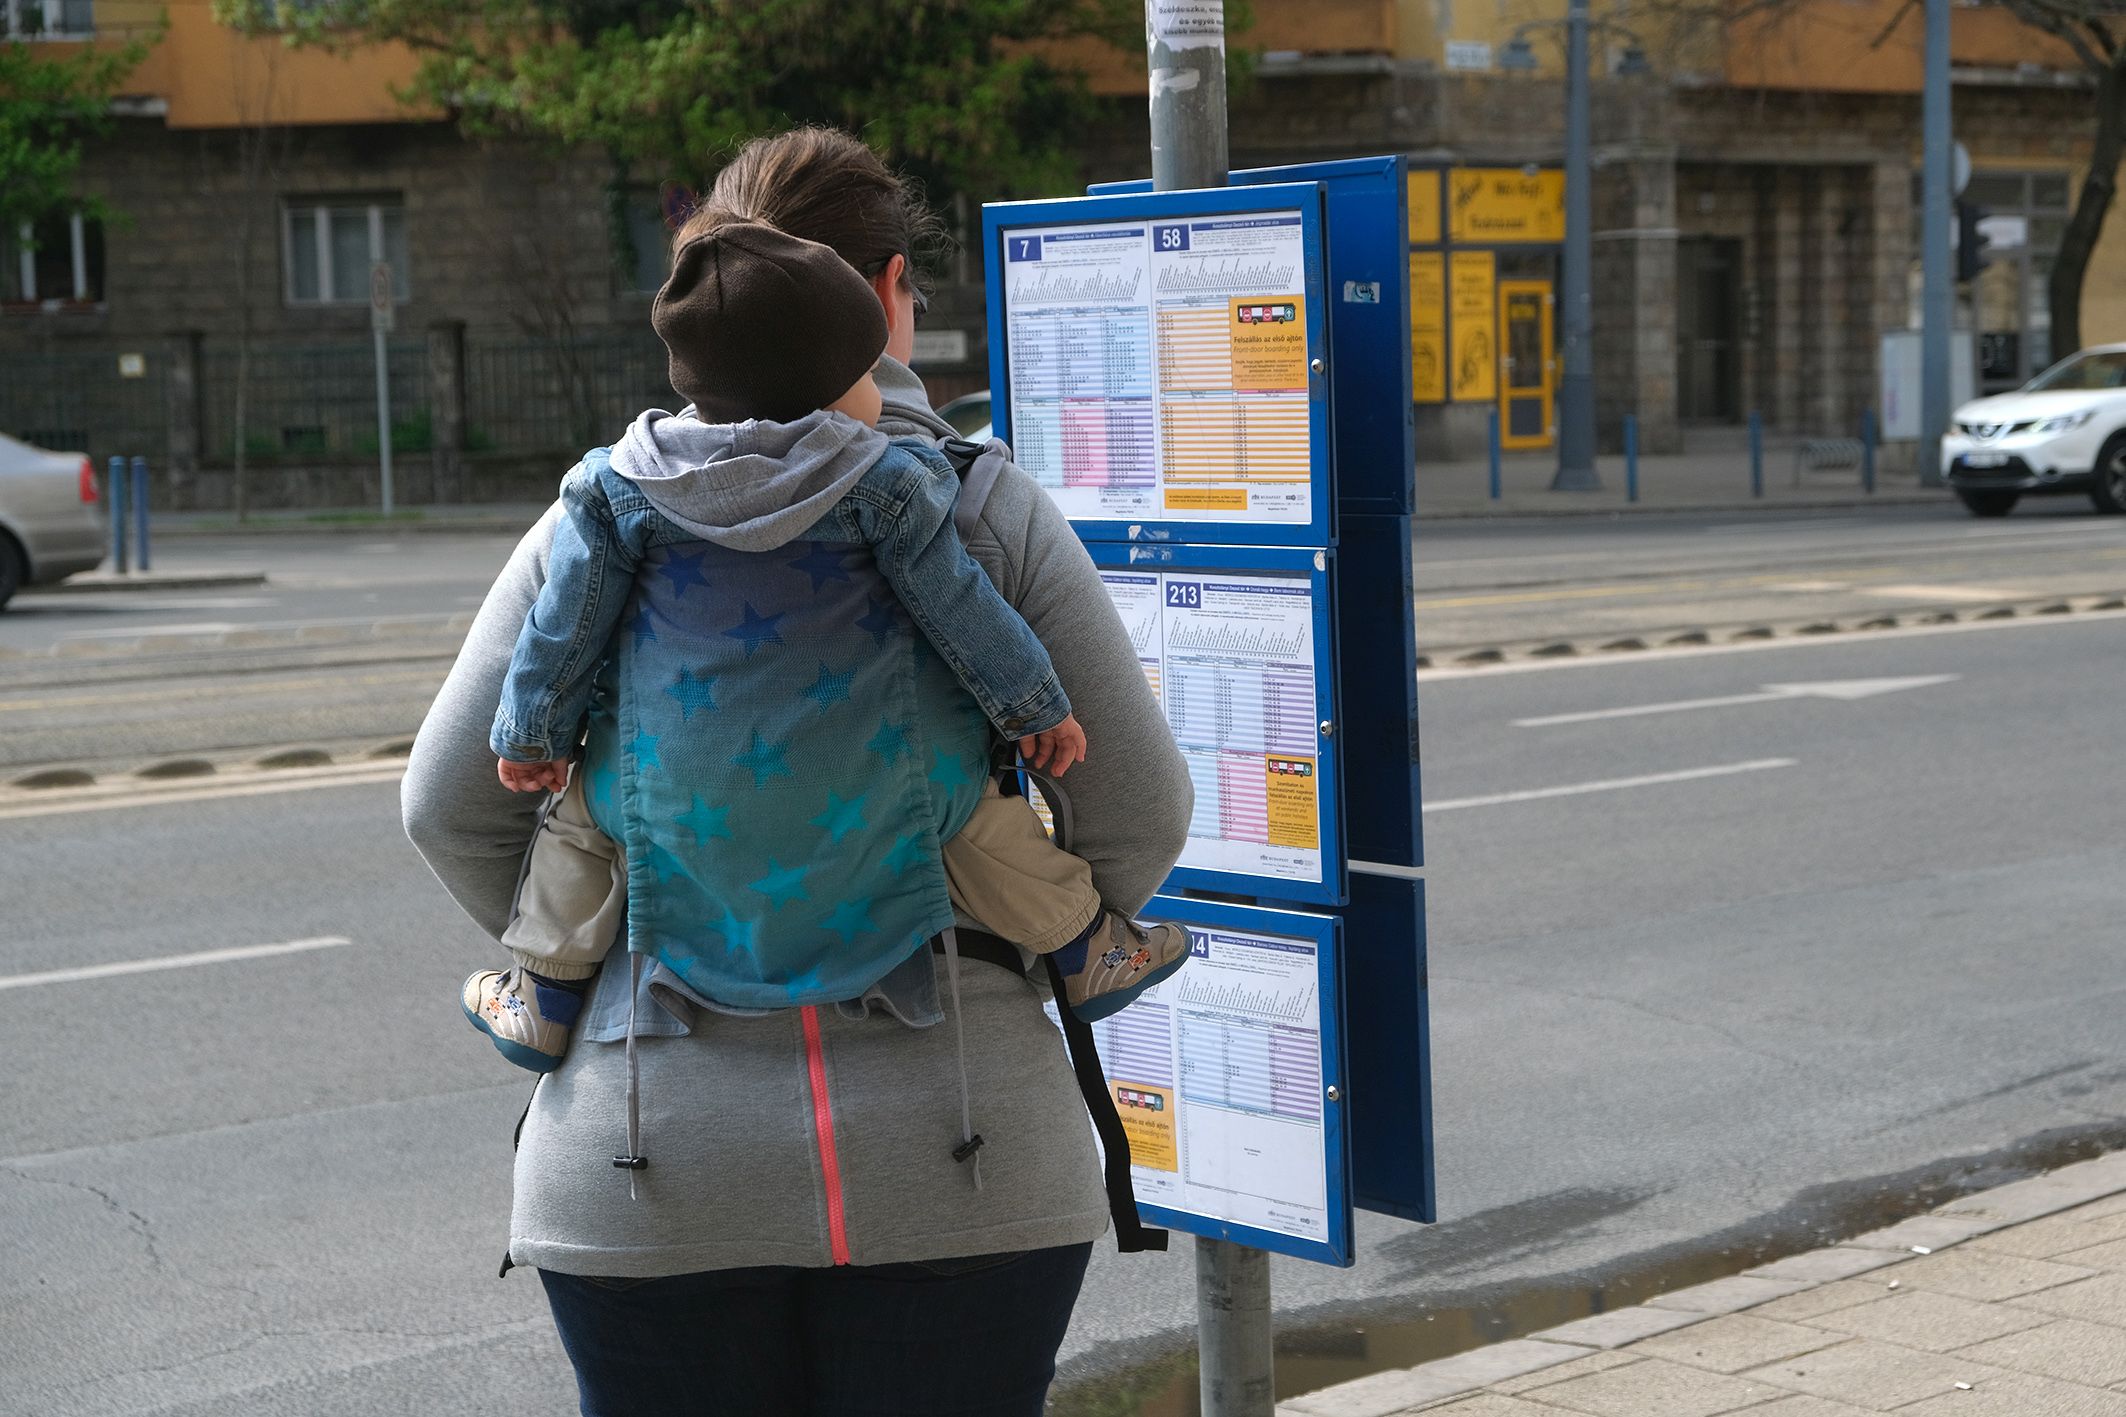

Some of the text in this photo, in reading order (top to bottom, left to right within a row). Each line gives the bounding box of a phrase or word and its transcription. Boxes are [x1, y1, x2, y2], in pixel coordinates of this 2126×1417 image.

[1162, 228, 1181, 248] 58
[1020, 240, 1030, 259] 7
[1169, 584, 1198, 605] 213
